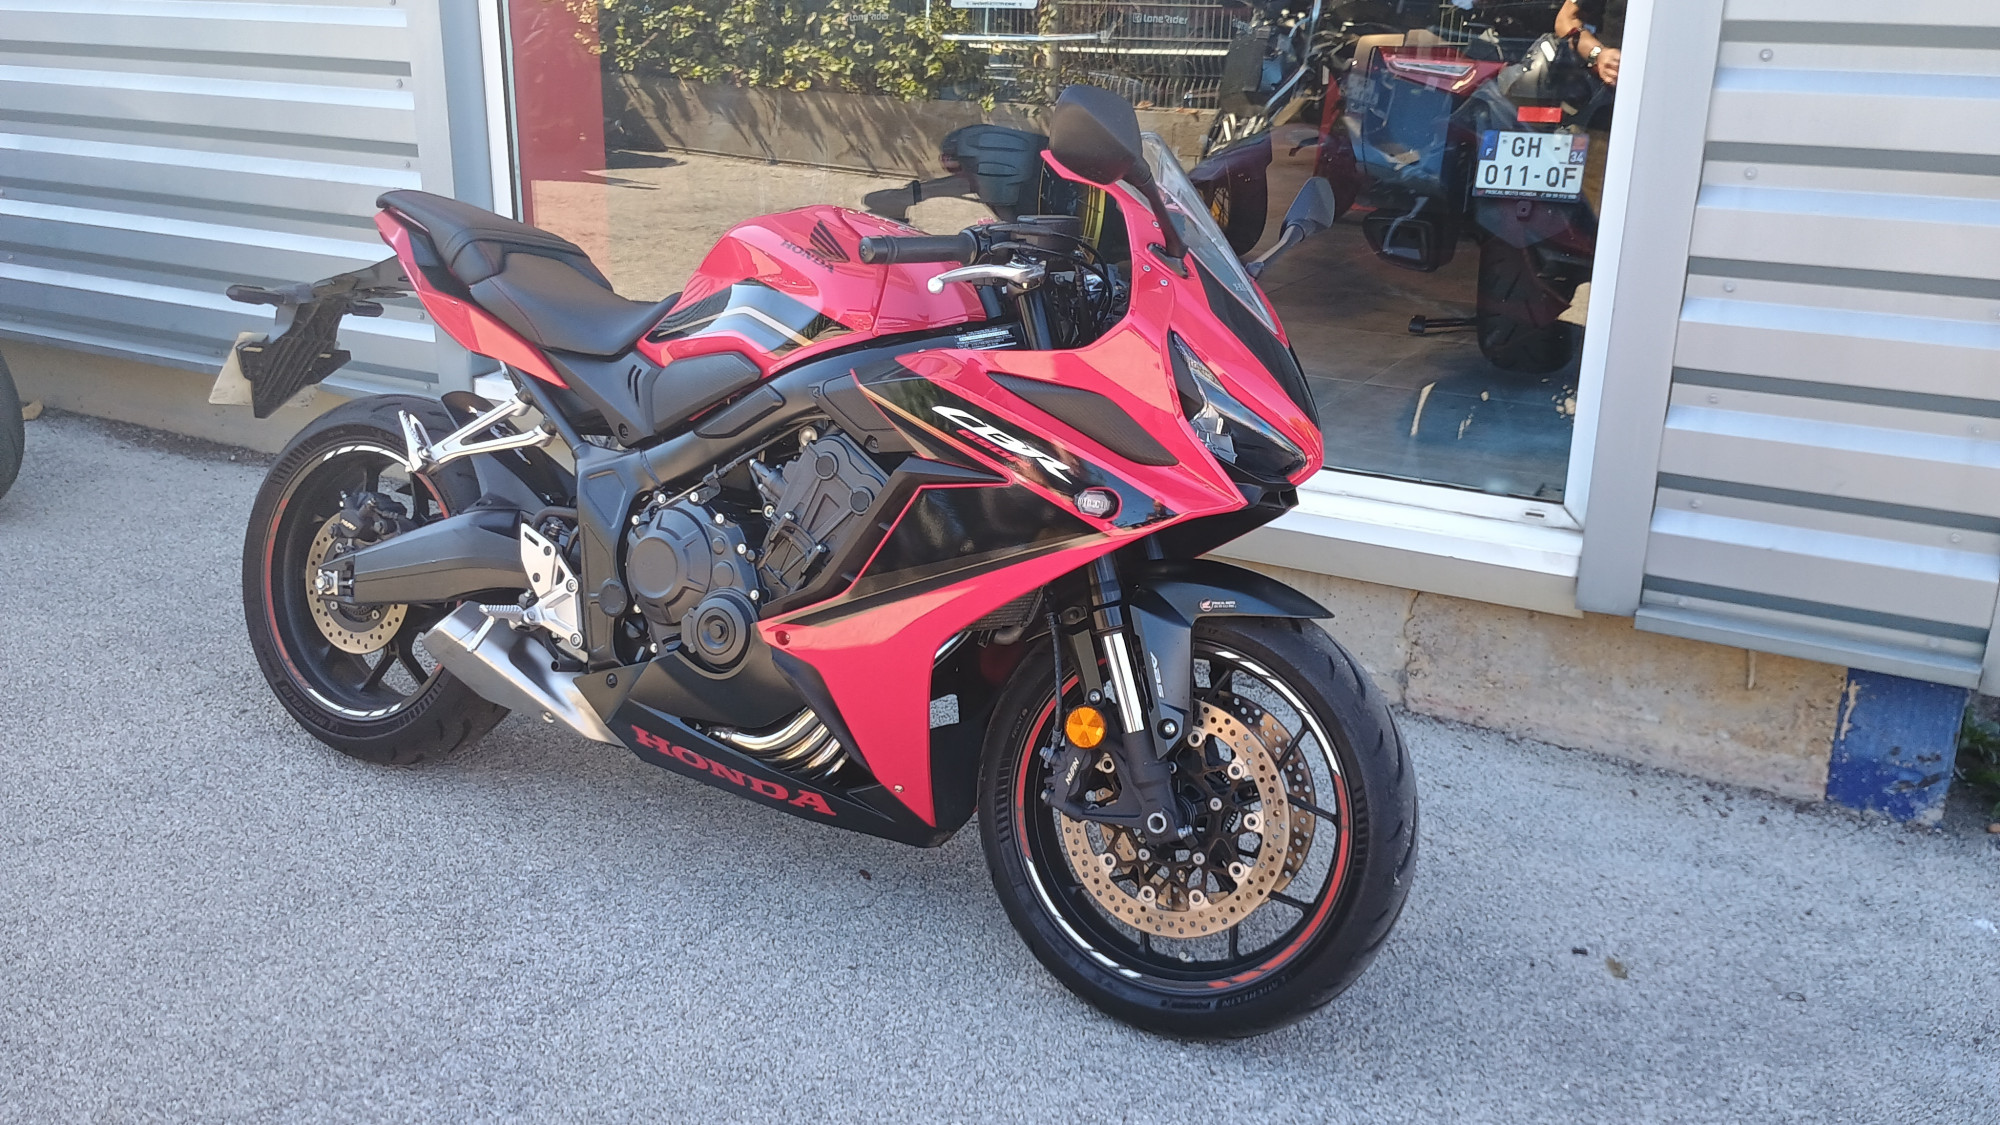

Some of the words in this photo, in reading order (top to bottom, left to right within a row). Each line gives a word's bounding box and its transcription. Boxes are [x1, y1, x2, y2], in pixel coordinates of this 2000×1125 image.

[1511, 137, 1542, 158] GH
[1484, 164, 1577, 188] 011-QF
[780, 239, 834, 274] HONDA
[931, 405, 1073, 485] CBR
[631, 724, 837, 816] HONDA
